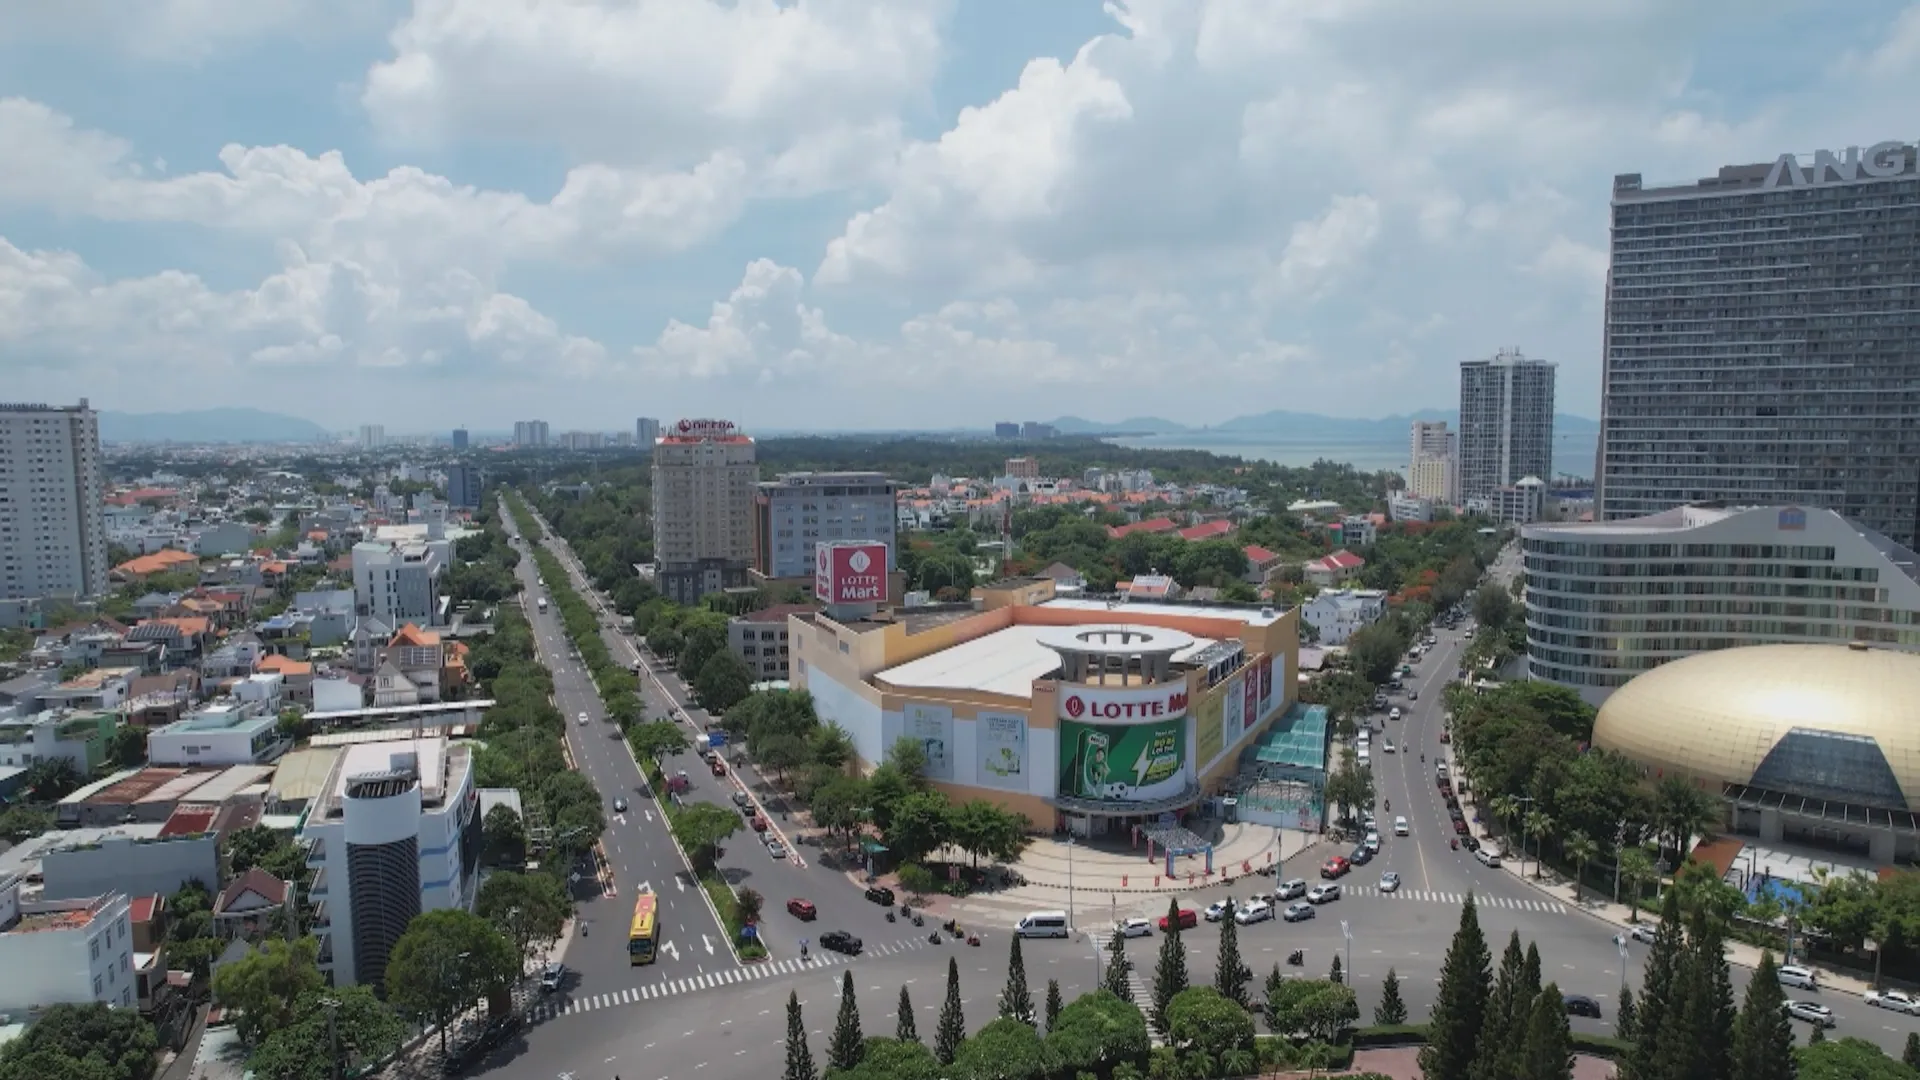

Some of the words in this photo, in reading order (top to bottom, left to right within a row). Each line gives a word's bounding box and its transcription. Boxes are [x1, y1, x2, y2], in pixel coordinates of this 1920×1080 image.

[841, 575, 879, 585] LOTTE
[842, 585, 879, 599] Mart
[1091, 700, 1164, 718] LOTTE
